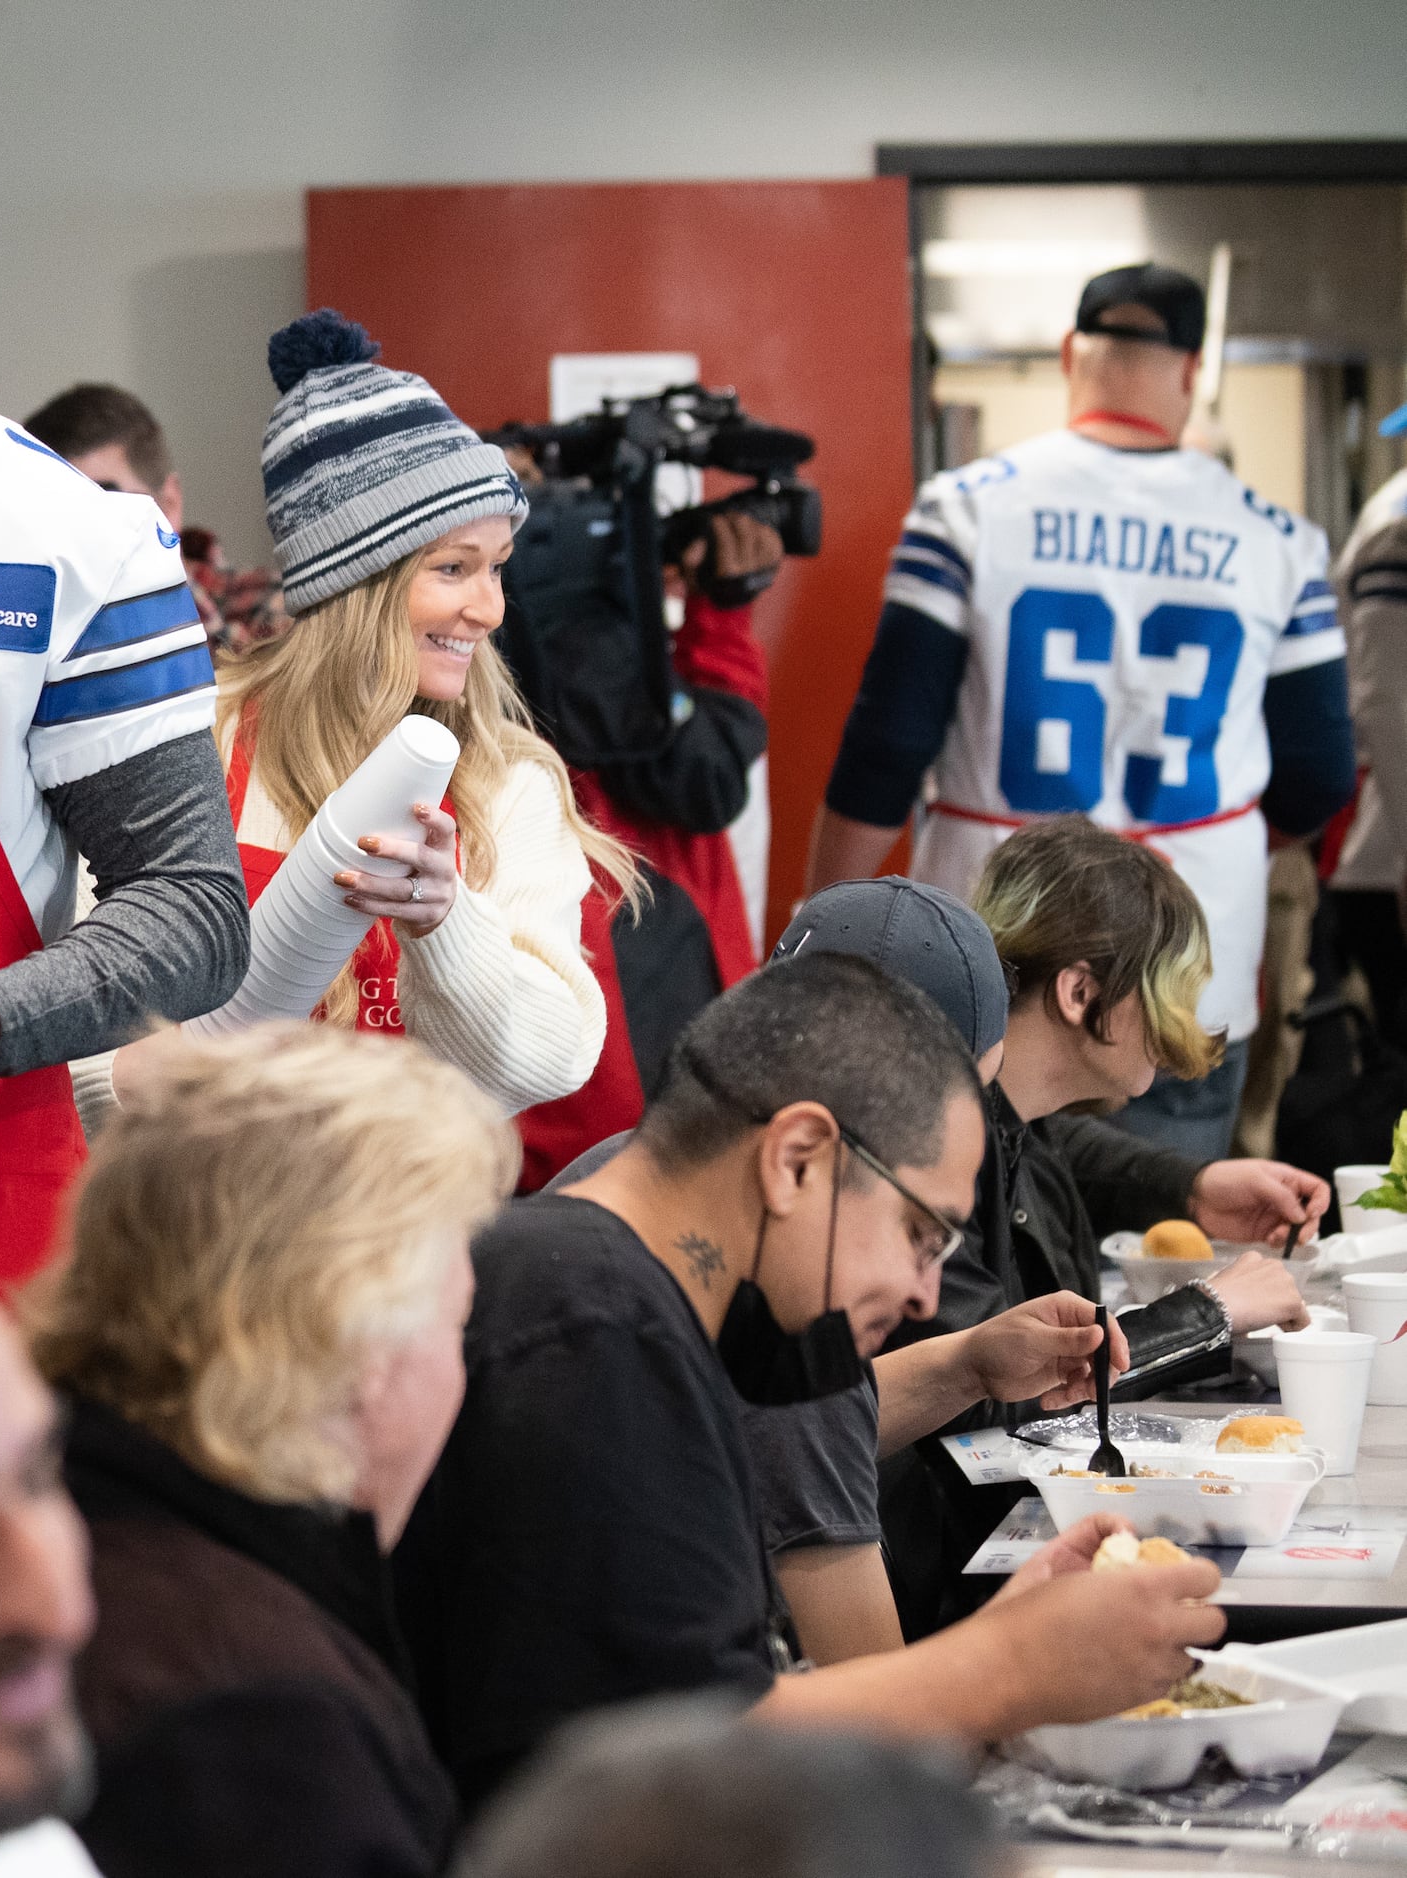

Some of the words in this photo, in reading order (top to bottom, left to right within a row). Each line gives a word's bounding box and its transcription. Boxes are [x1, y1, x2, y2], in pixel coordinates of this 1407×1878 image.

[1032, 508, 1240, 585] BIADASZ
[998, 584, 1246, 827] 63
[364, 1005, 402, 1027] GO
